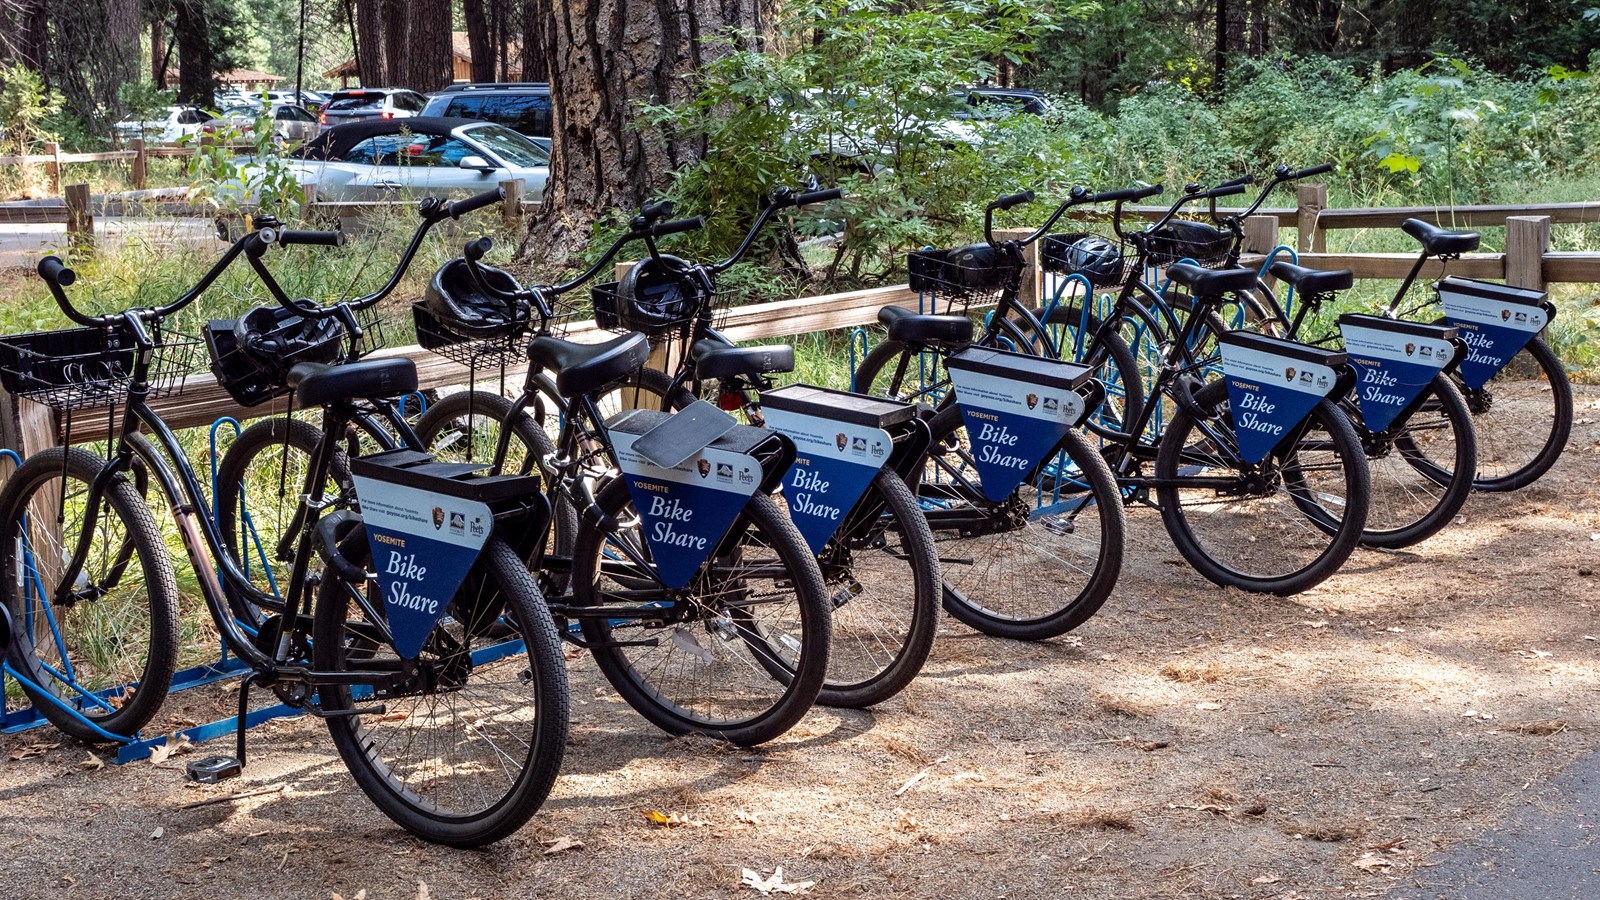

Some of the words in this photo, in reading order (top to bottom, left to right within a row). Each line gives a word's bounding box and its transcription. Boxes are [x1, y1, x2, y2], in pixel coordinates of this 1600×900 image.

[1453, 322, 1479, 331] YOSEMITE
[1464, 331, 1494, 349] Bike
[1354, 359, 1381, 367] YOSEMITE
[1464, 348, 1502, 366] Share
[1232, 381, 1259, 391] YOSEMITE
[1363, 368, 1398, 387] Bike
[1239, 392, 1275, 414] Bike
[1363, 386, 1405, 406] Share
[967, 410, 999, 422] YOSEMITE
[1238, 412, 1283, 435] Share
[978, 423, 1018, 446] Bike
[795, 457, 811, 466] MITE
[978, 444, 1028, 470] Share
[633, 481, 669, 493] YOSEMITE
[791, 468, 830, 493] Bike
[648, 496, 693, 522] Bike
[793, 493, 840, 520] Share
[374, 533, 405, 548] YOSEMITE
[652, 522, 707, 550] Share
[386, 551, 426, 581] Bike
[388, 581, 438, 614] Share
